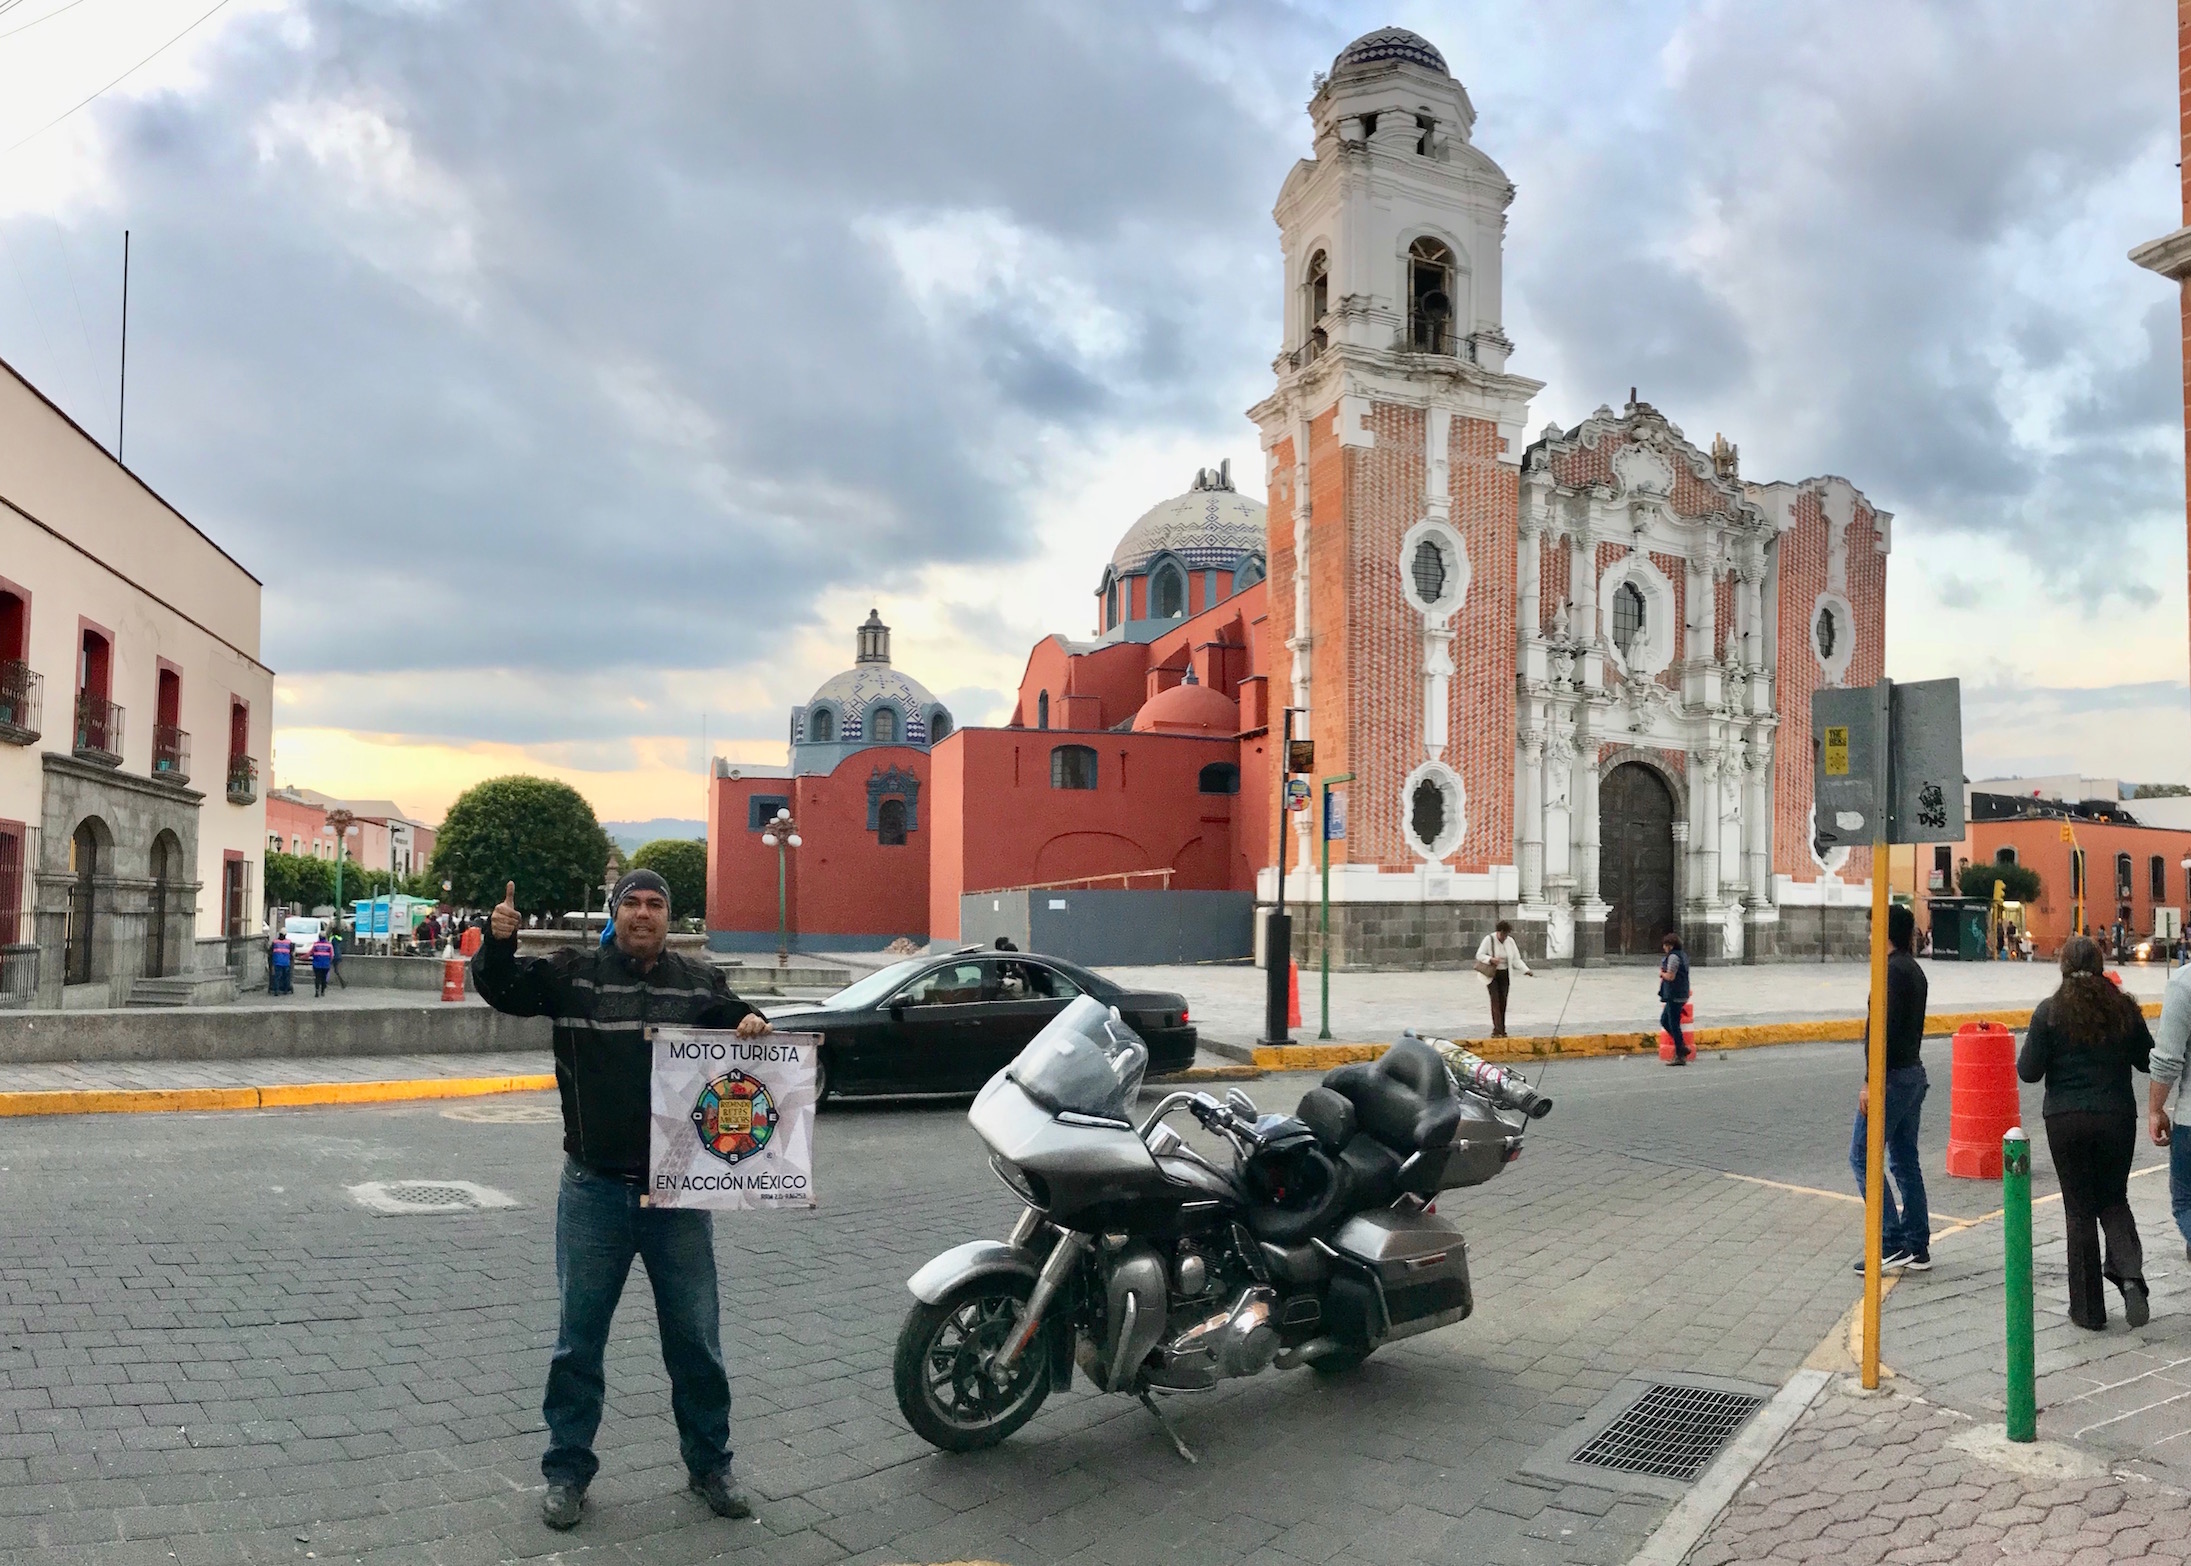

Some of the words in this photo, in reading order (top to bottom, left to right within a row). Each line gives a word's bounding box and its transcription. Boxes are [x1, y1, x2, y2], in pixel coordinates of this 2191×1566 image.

[669, 1041, 726, 1060] MOTO
[730, 1043, 800, 1063] TURISTA
[656, 1174, 677, 1190] EN
[681, 1172, 743, 1191] ACCIÓN
[747, 1171, 807, 1190] MÉXICO
